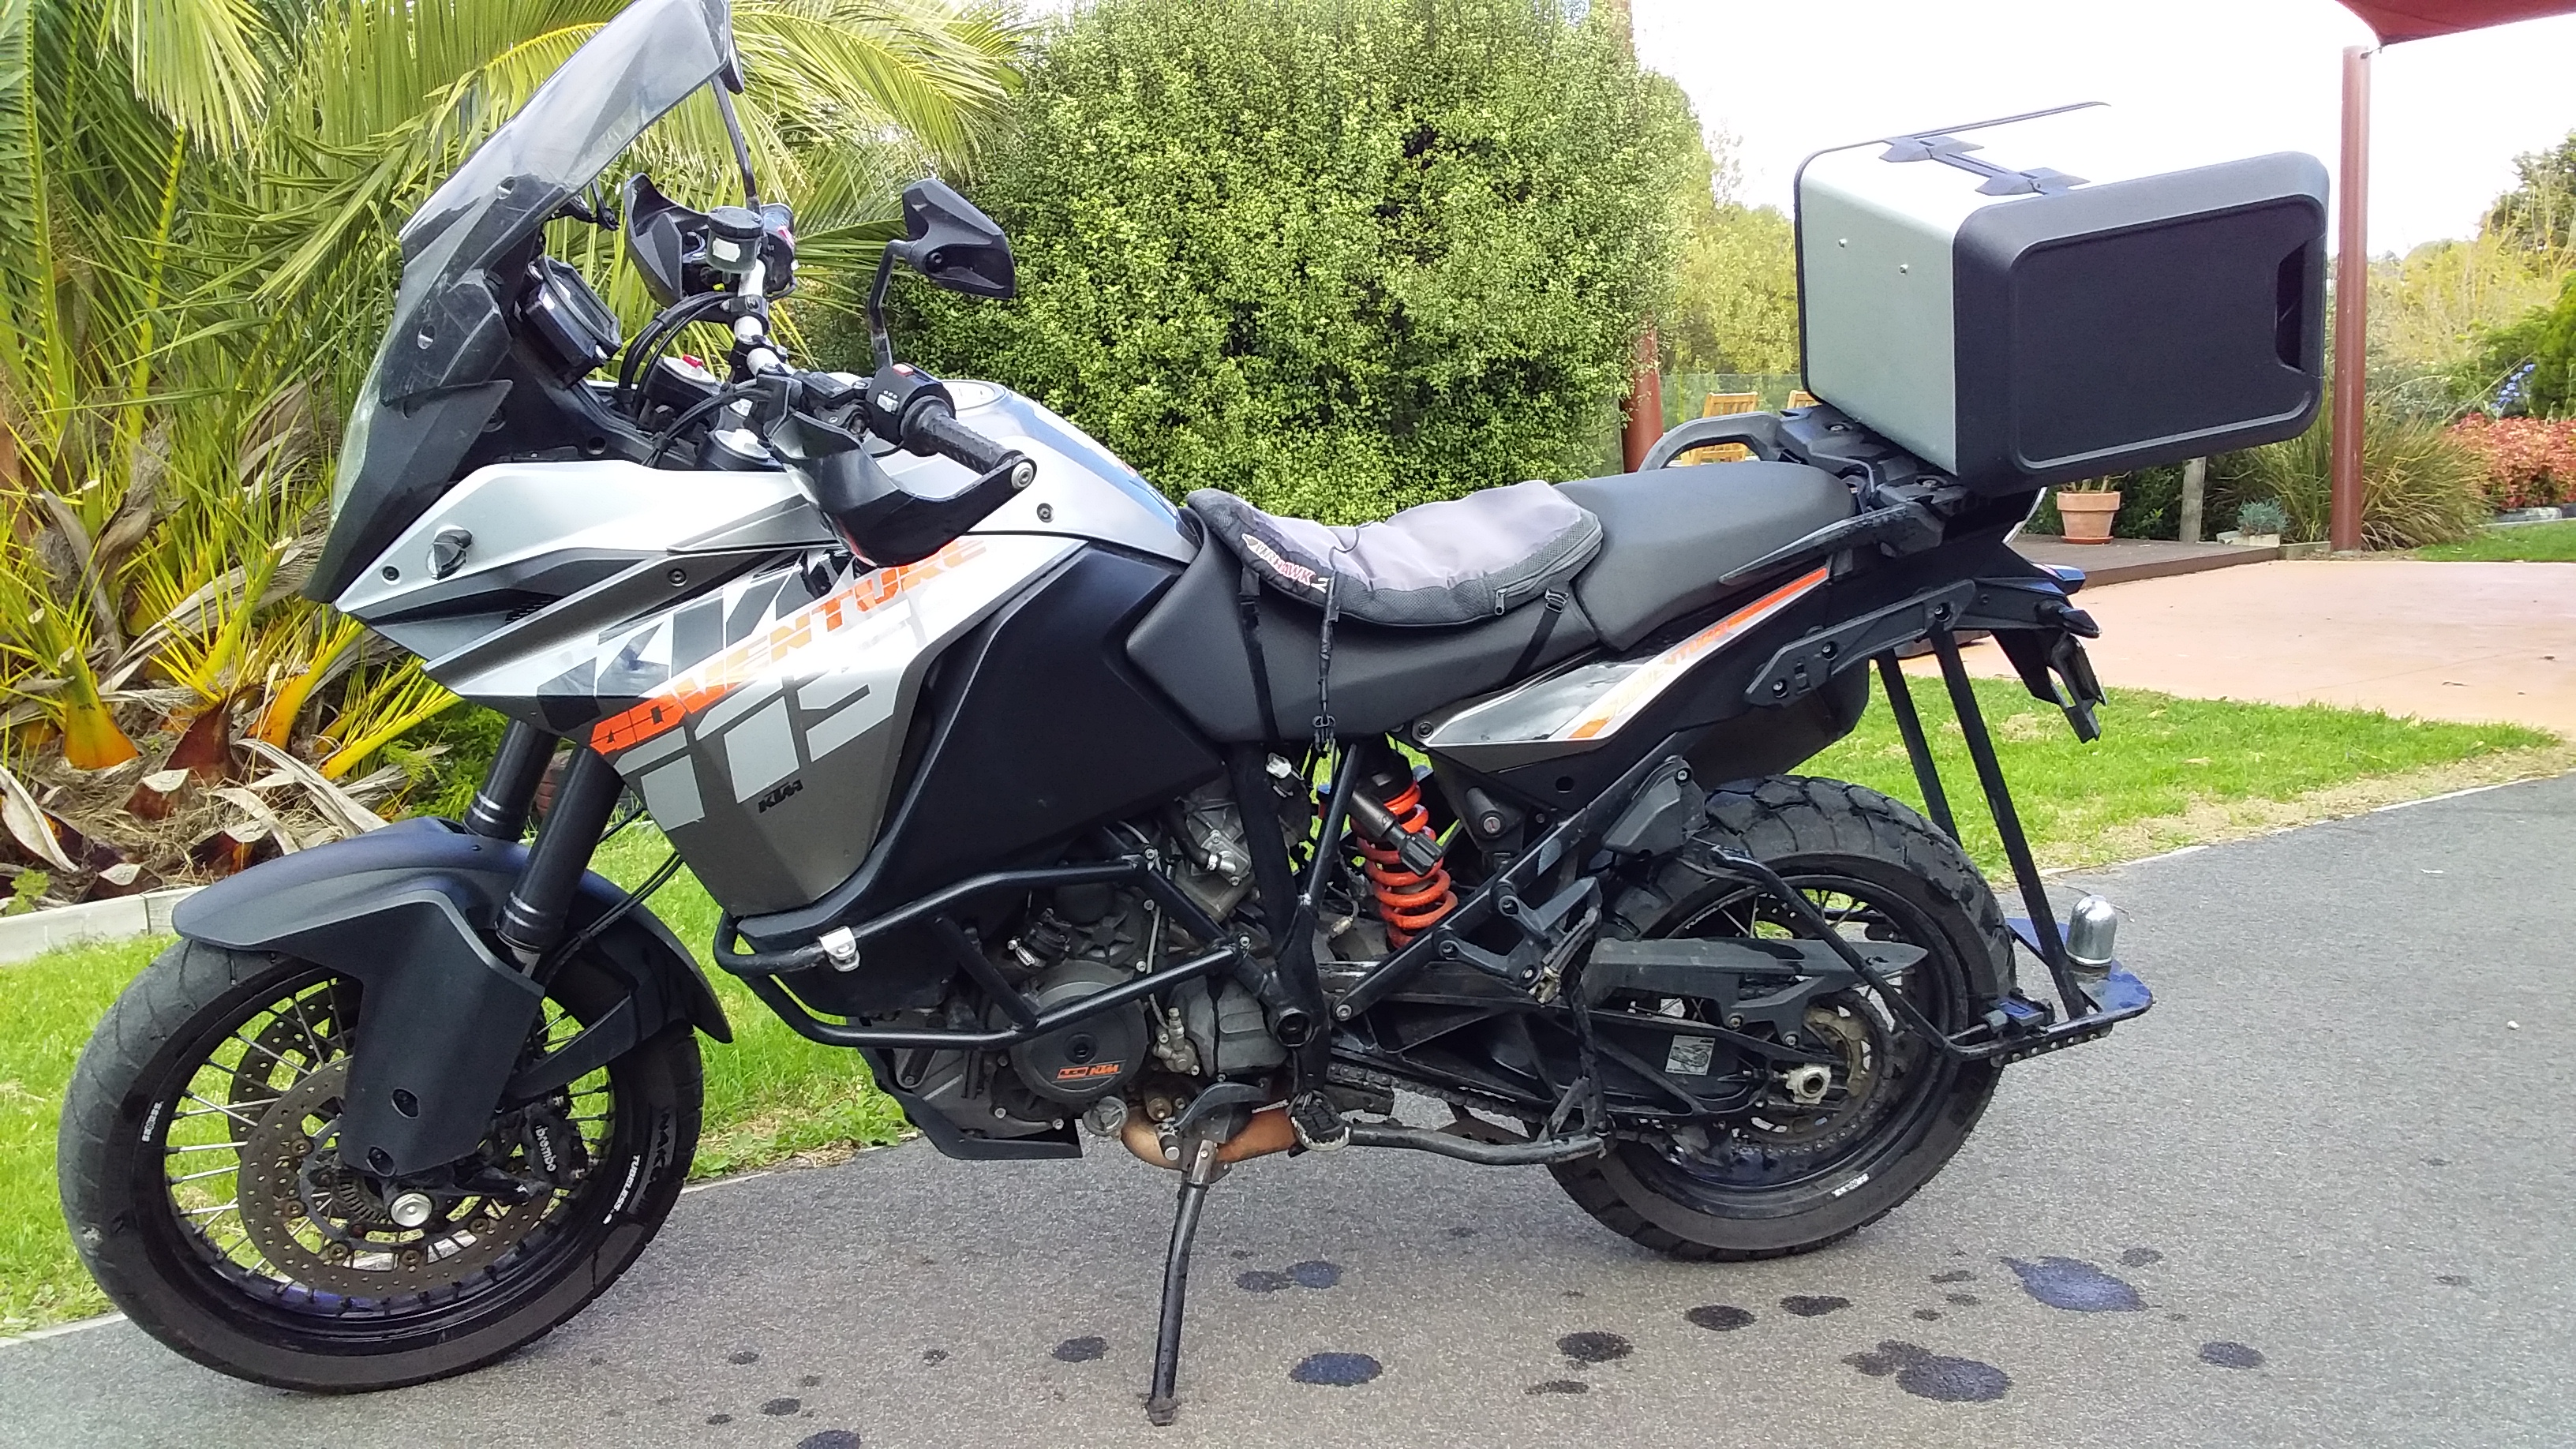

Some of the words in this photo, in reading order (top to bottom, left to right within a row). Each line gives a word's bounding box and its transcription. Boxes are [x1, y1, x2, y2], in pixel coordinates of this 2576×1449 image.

[590, 540, 987, 755] ADVENTURE
[758, 778, 803, 814] KTM
[535, 1125, 557, 1172] brembo
